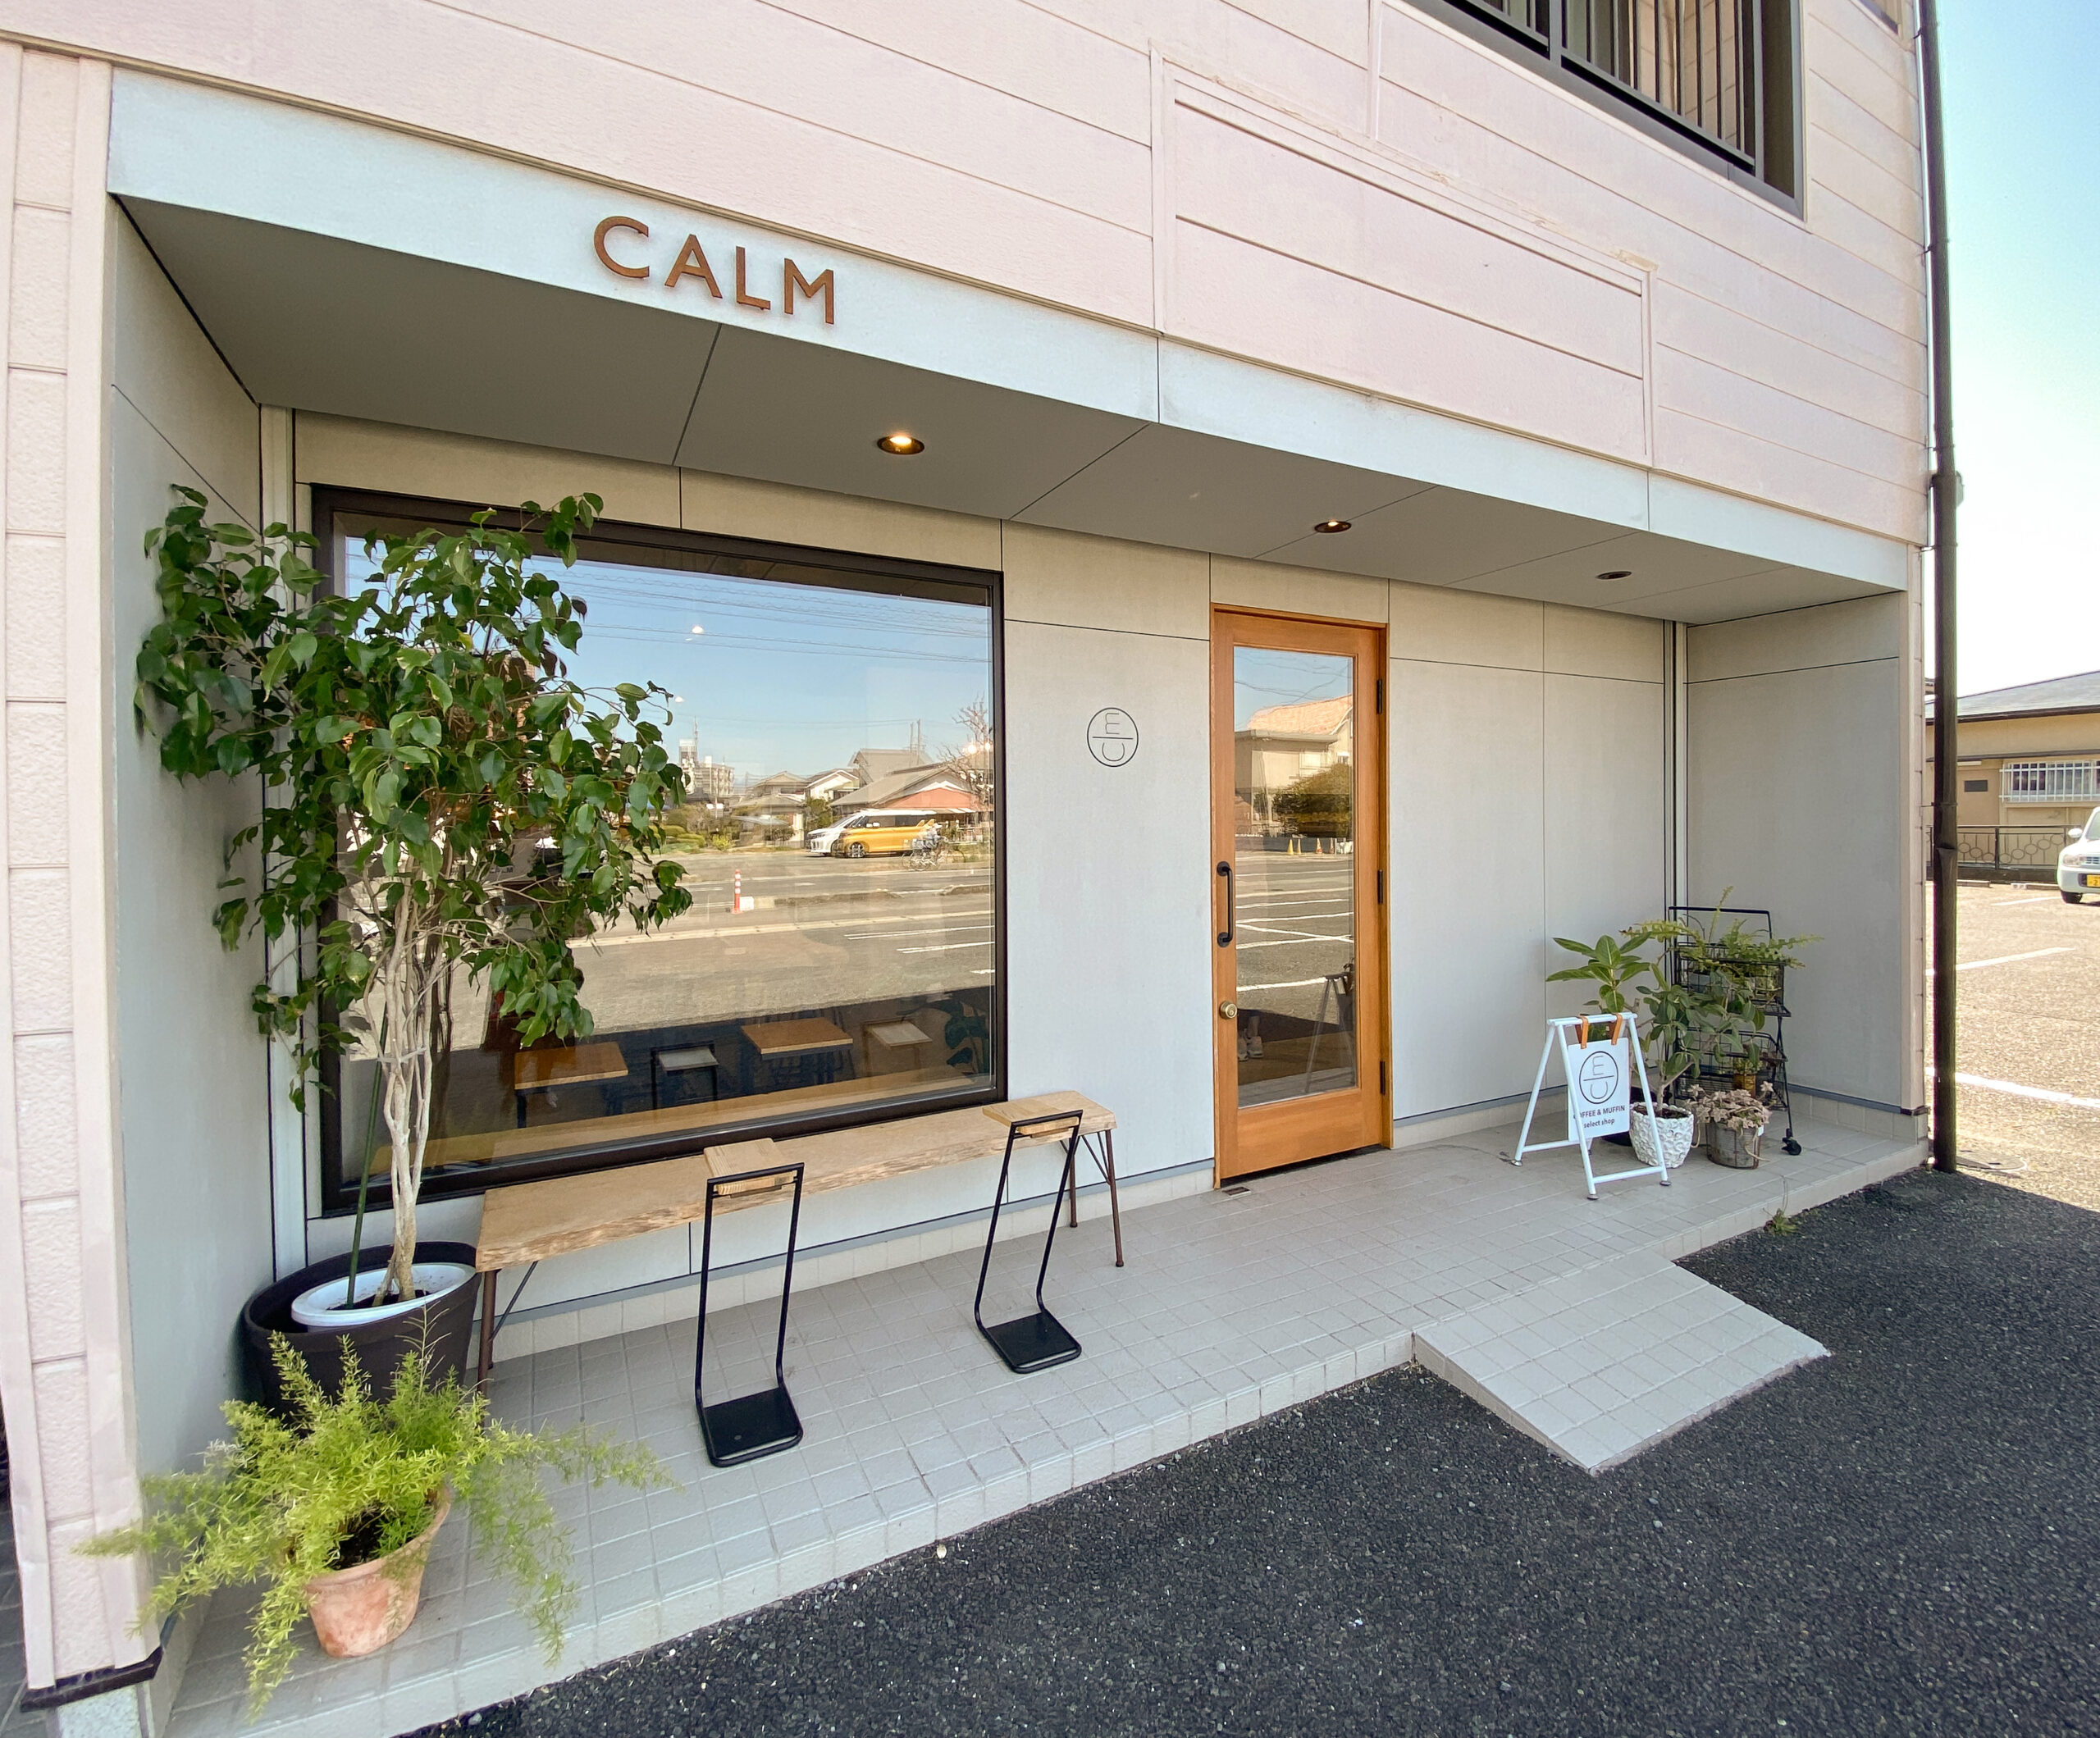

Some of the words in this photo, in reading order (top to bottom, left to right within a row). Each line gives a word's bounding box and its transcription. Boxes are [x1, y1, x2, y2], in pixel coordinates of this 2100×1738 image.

[593, 215, 835, 325] CALM
[1573, 1110, 1596, 1120] FFEE
[1602, 1105, 1625, 1114] MUFFIN
[1583, 1120, 1600, 1128] select
